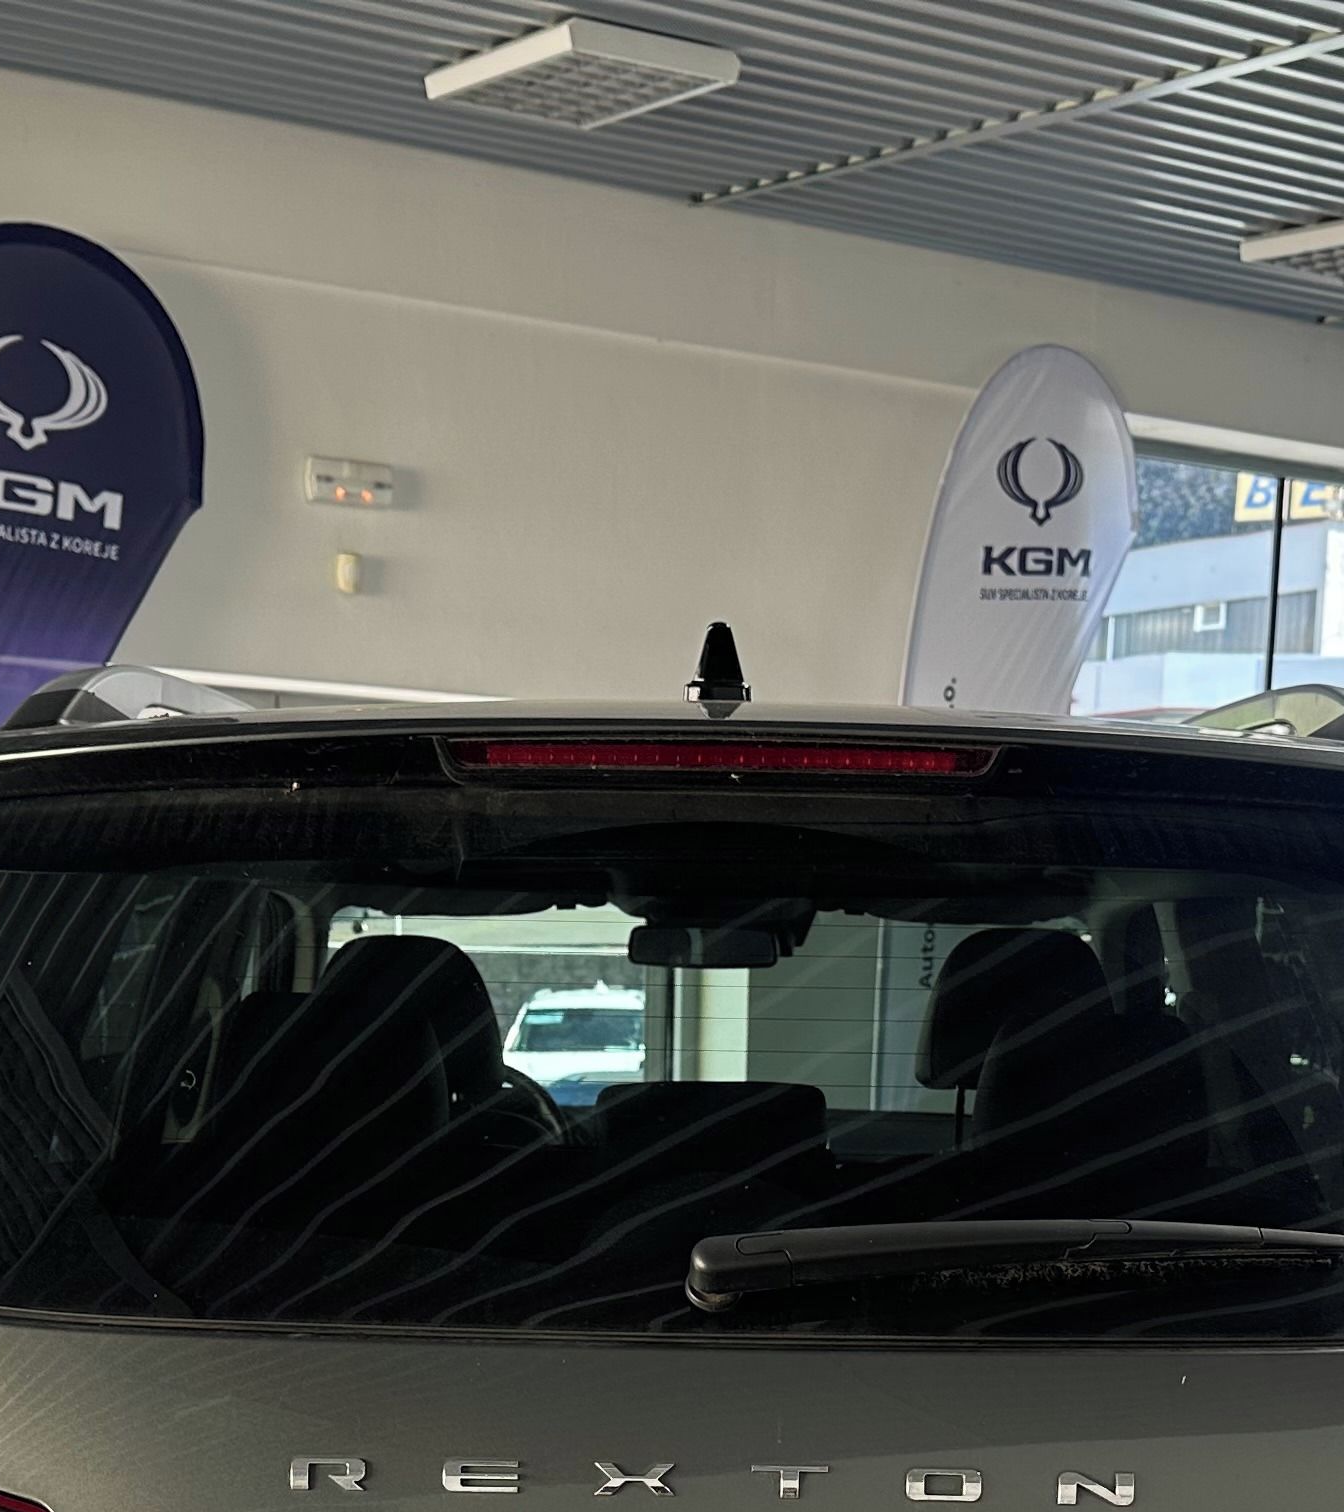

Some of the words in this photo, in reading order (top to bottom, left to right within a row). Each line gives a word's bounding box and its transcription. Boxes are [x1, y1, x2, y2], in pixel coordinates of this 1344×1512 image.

[49, 533, 60, 549] Z
[61, 534, 120, 561] KOREJE
[982, 546, 1091, 577] KGM
[289, 1457, 1136, 1506] REXTON
